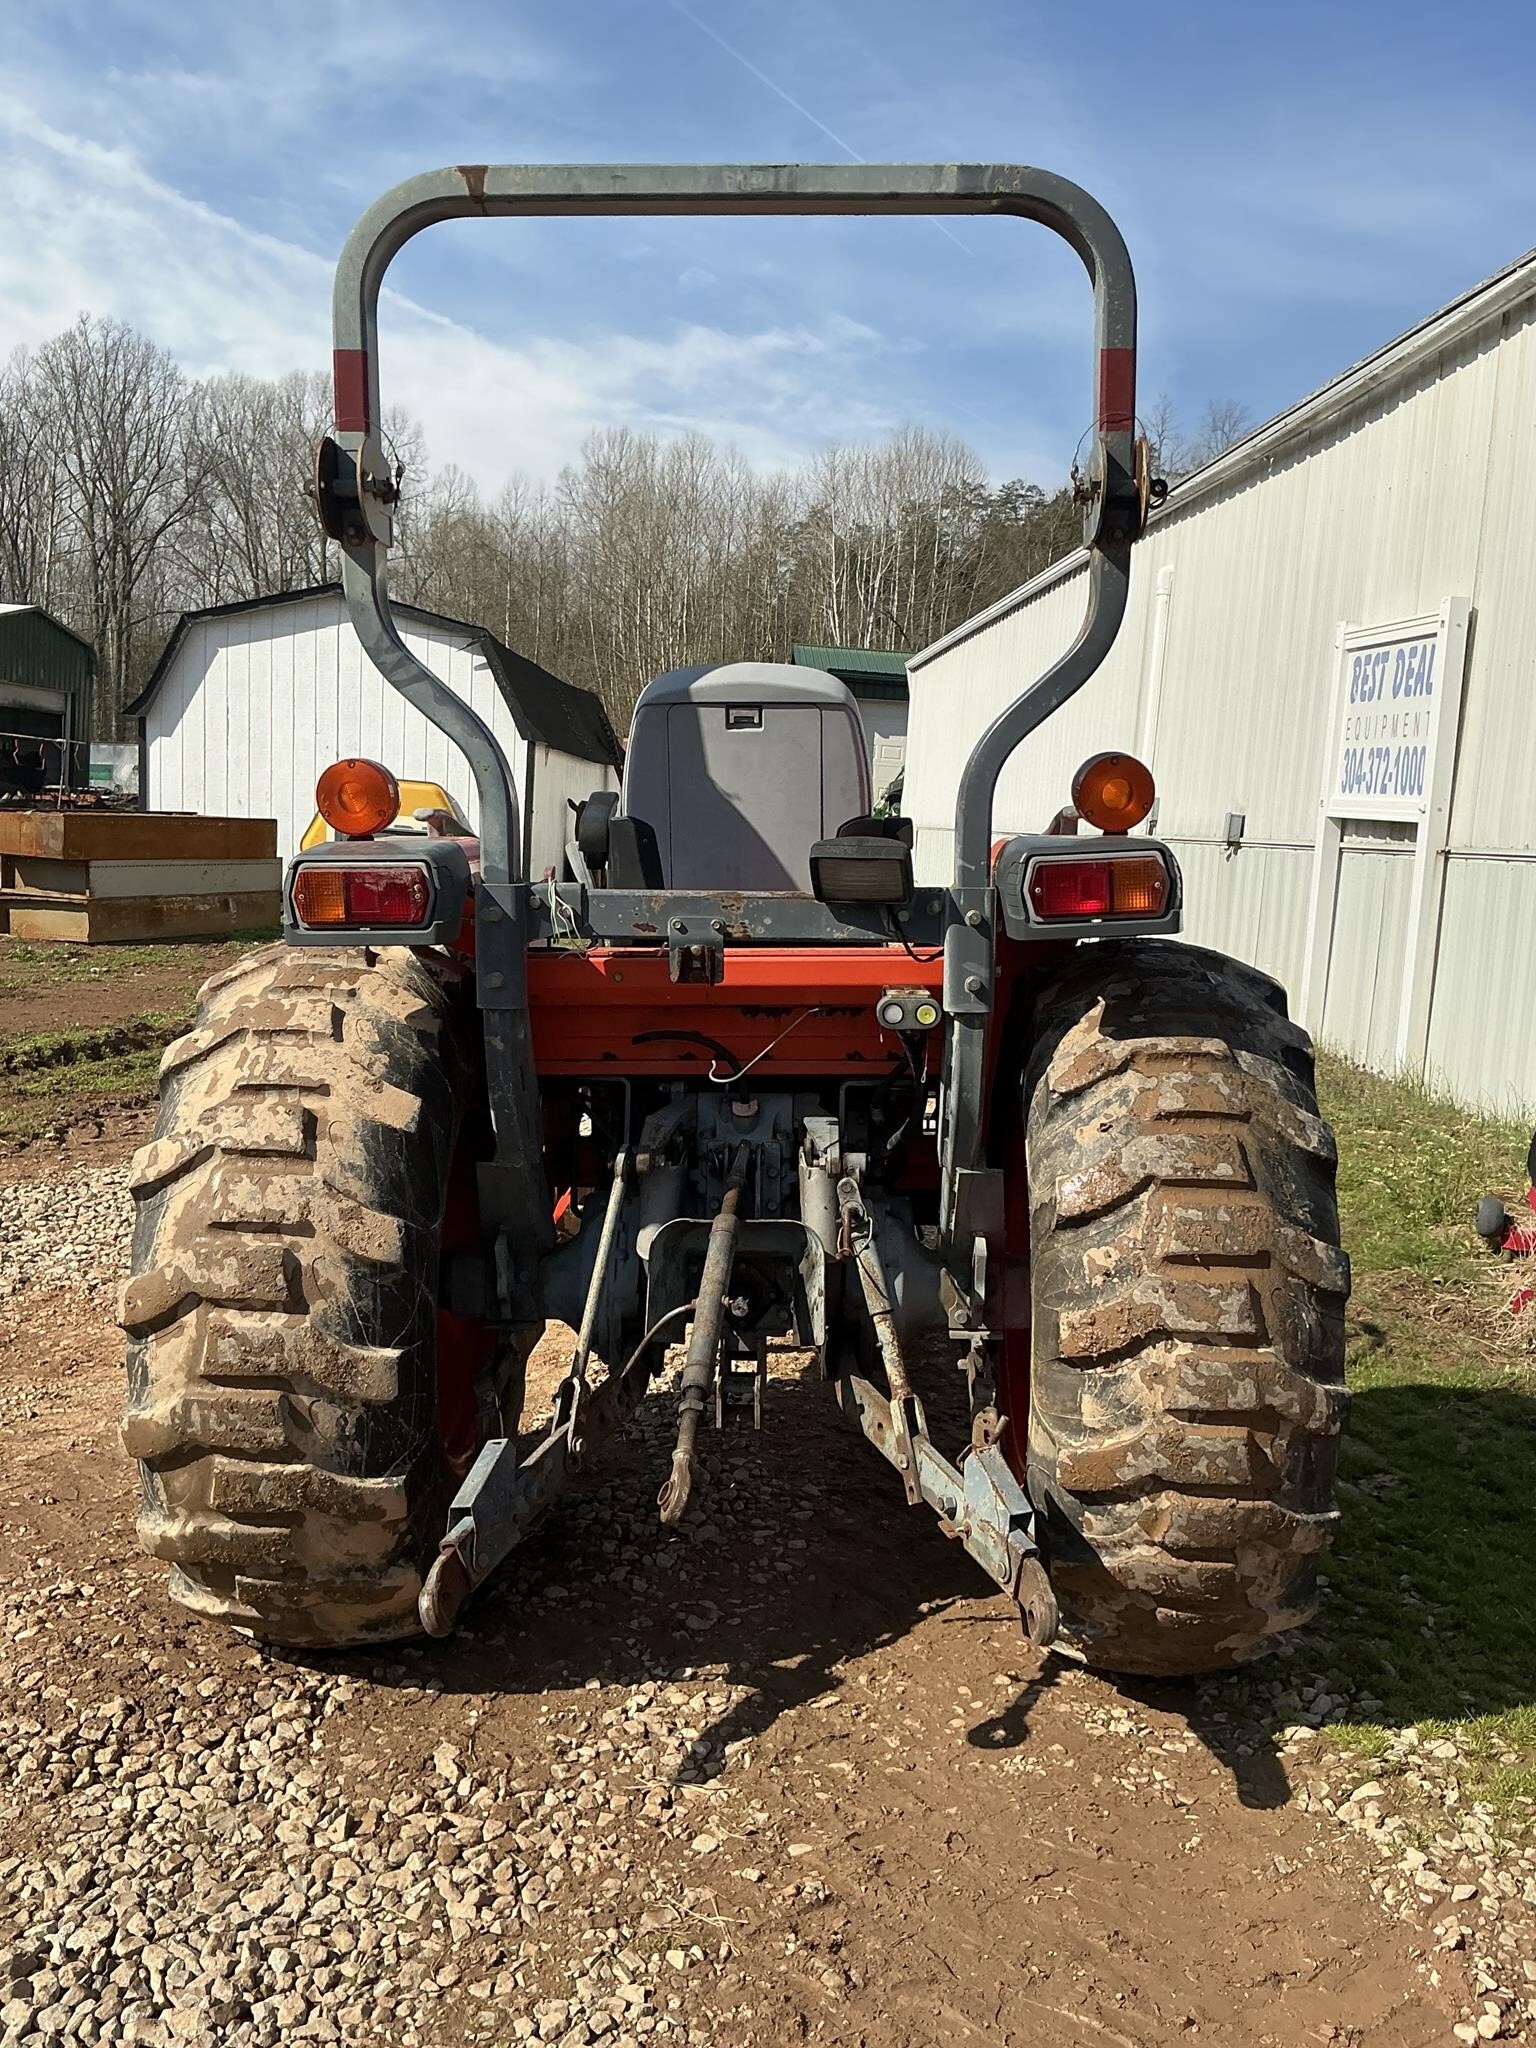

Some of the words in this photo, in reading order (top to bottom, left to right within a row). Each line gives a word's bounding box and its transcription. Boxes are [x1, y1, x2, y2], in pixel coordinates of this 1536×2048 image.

[1350, 650, 1390, 704] BEST
[1391, 643, 1437, 700] DEAL
[1345, 711, 1431, 741] EQUIPMENT
[1341, 745, 1427, 796] 304-372-1000
